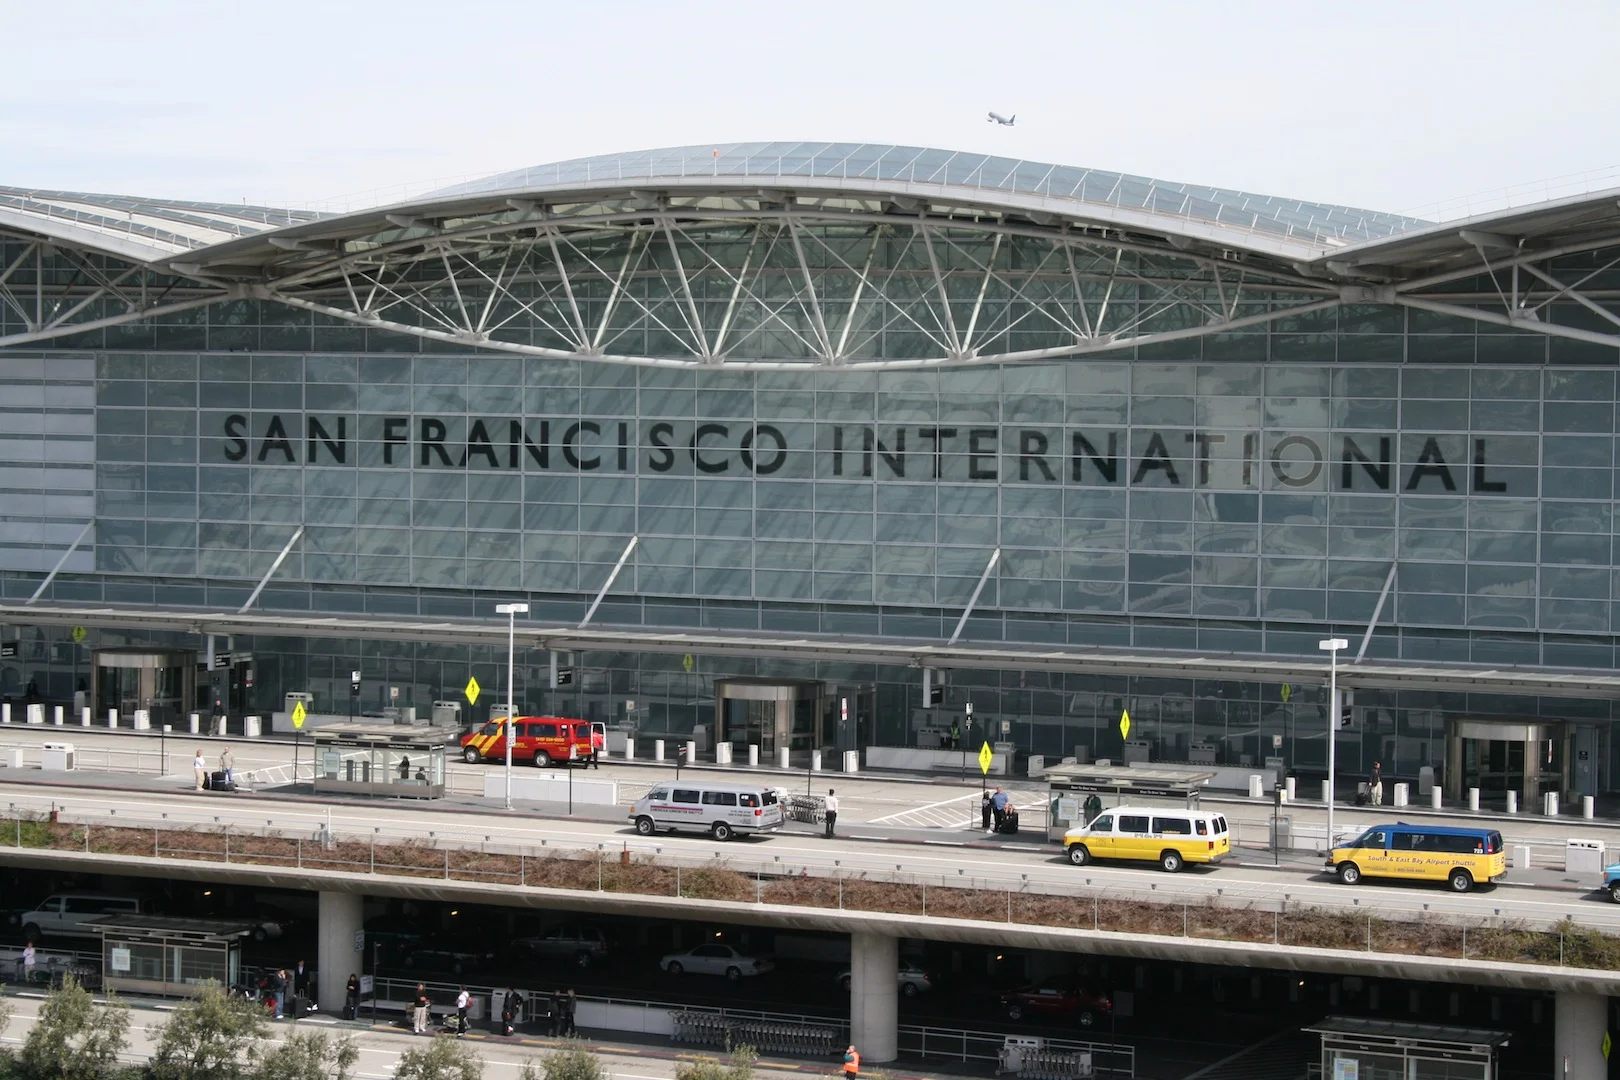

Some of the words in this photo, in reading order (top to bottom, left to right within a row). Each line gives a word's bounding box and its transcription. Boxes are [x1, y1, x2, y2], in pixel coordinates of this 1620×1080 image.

[223, 414, 346, 464] SAN
[383, 417, 787, 475] FRANCISCO
[833, 426, 1507, 492] INTERNATIONAL
[1426, 858, 1450, 866] Airport
